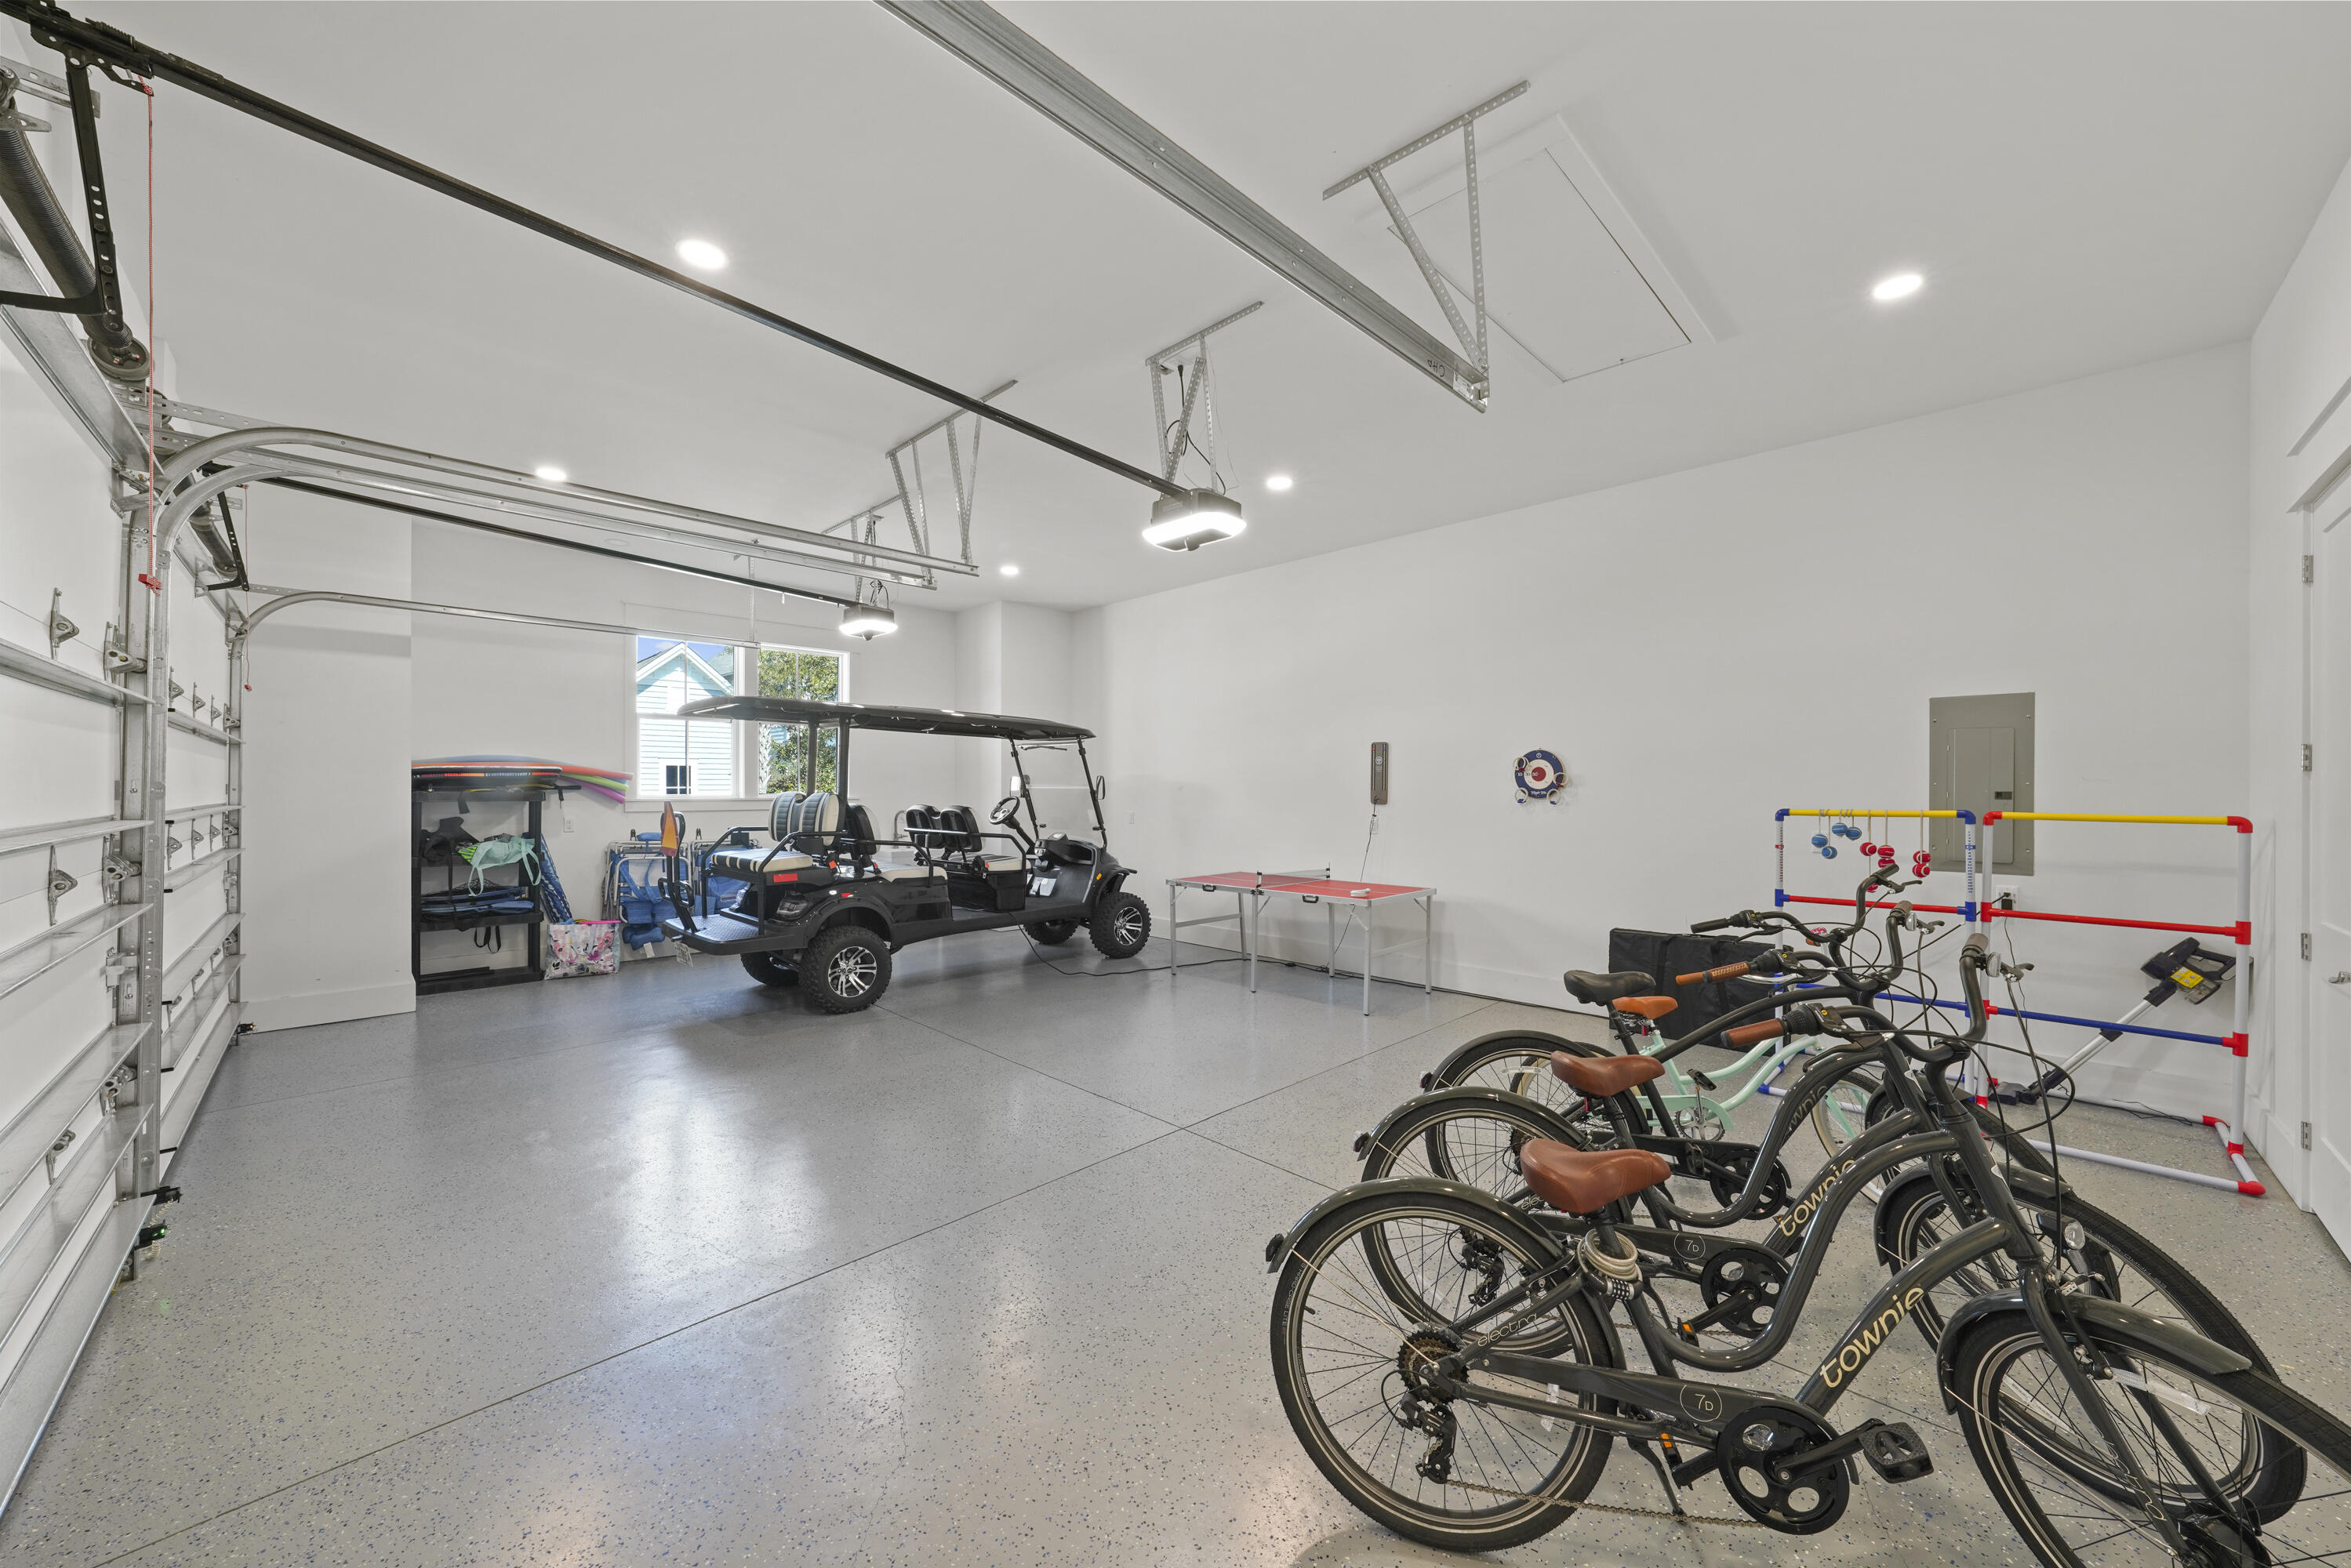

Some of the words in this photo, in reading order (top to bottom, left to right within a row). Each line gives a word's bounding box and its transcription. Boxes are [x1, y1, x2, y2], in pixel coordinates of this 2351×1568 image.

[1789, 1085, 1828, 1127] wni
[1477, 1313, 1537, 1347] electra
[1819, 1287, 1924, 1388] townie
[1694, 1393, 1713, 1411] 7D
